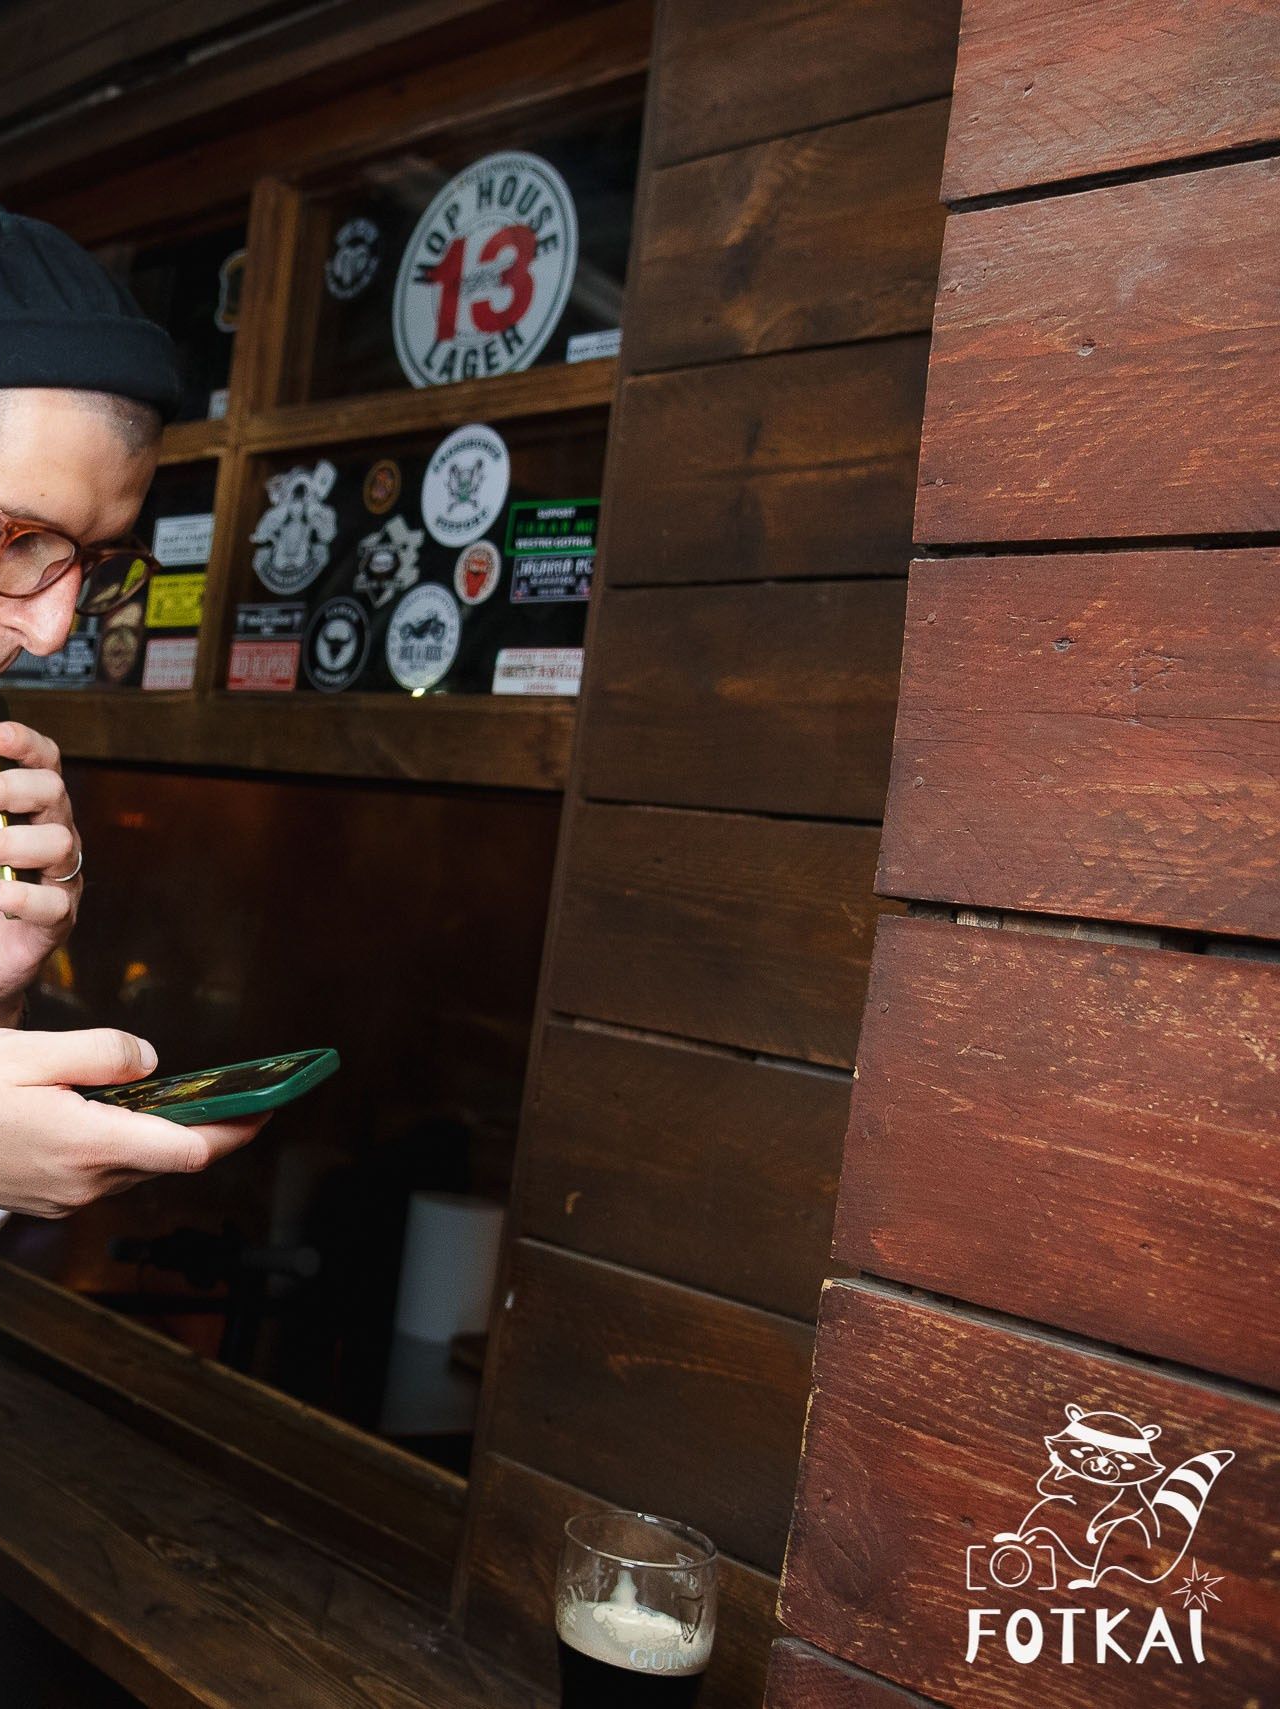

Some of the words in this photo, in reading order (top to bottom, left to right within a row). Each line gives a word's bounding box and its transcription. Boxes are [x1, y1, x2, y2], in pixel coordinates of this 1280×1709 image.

[413, 203, 461, 286] HOP
[477, 174, 560, 258] HOUSE
[424, 224, 538, 342] 13
[423, 325, 525, 382] LAGER
